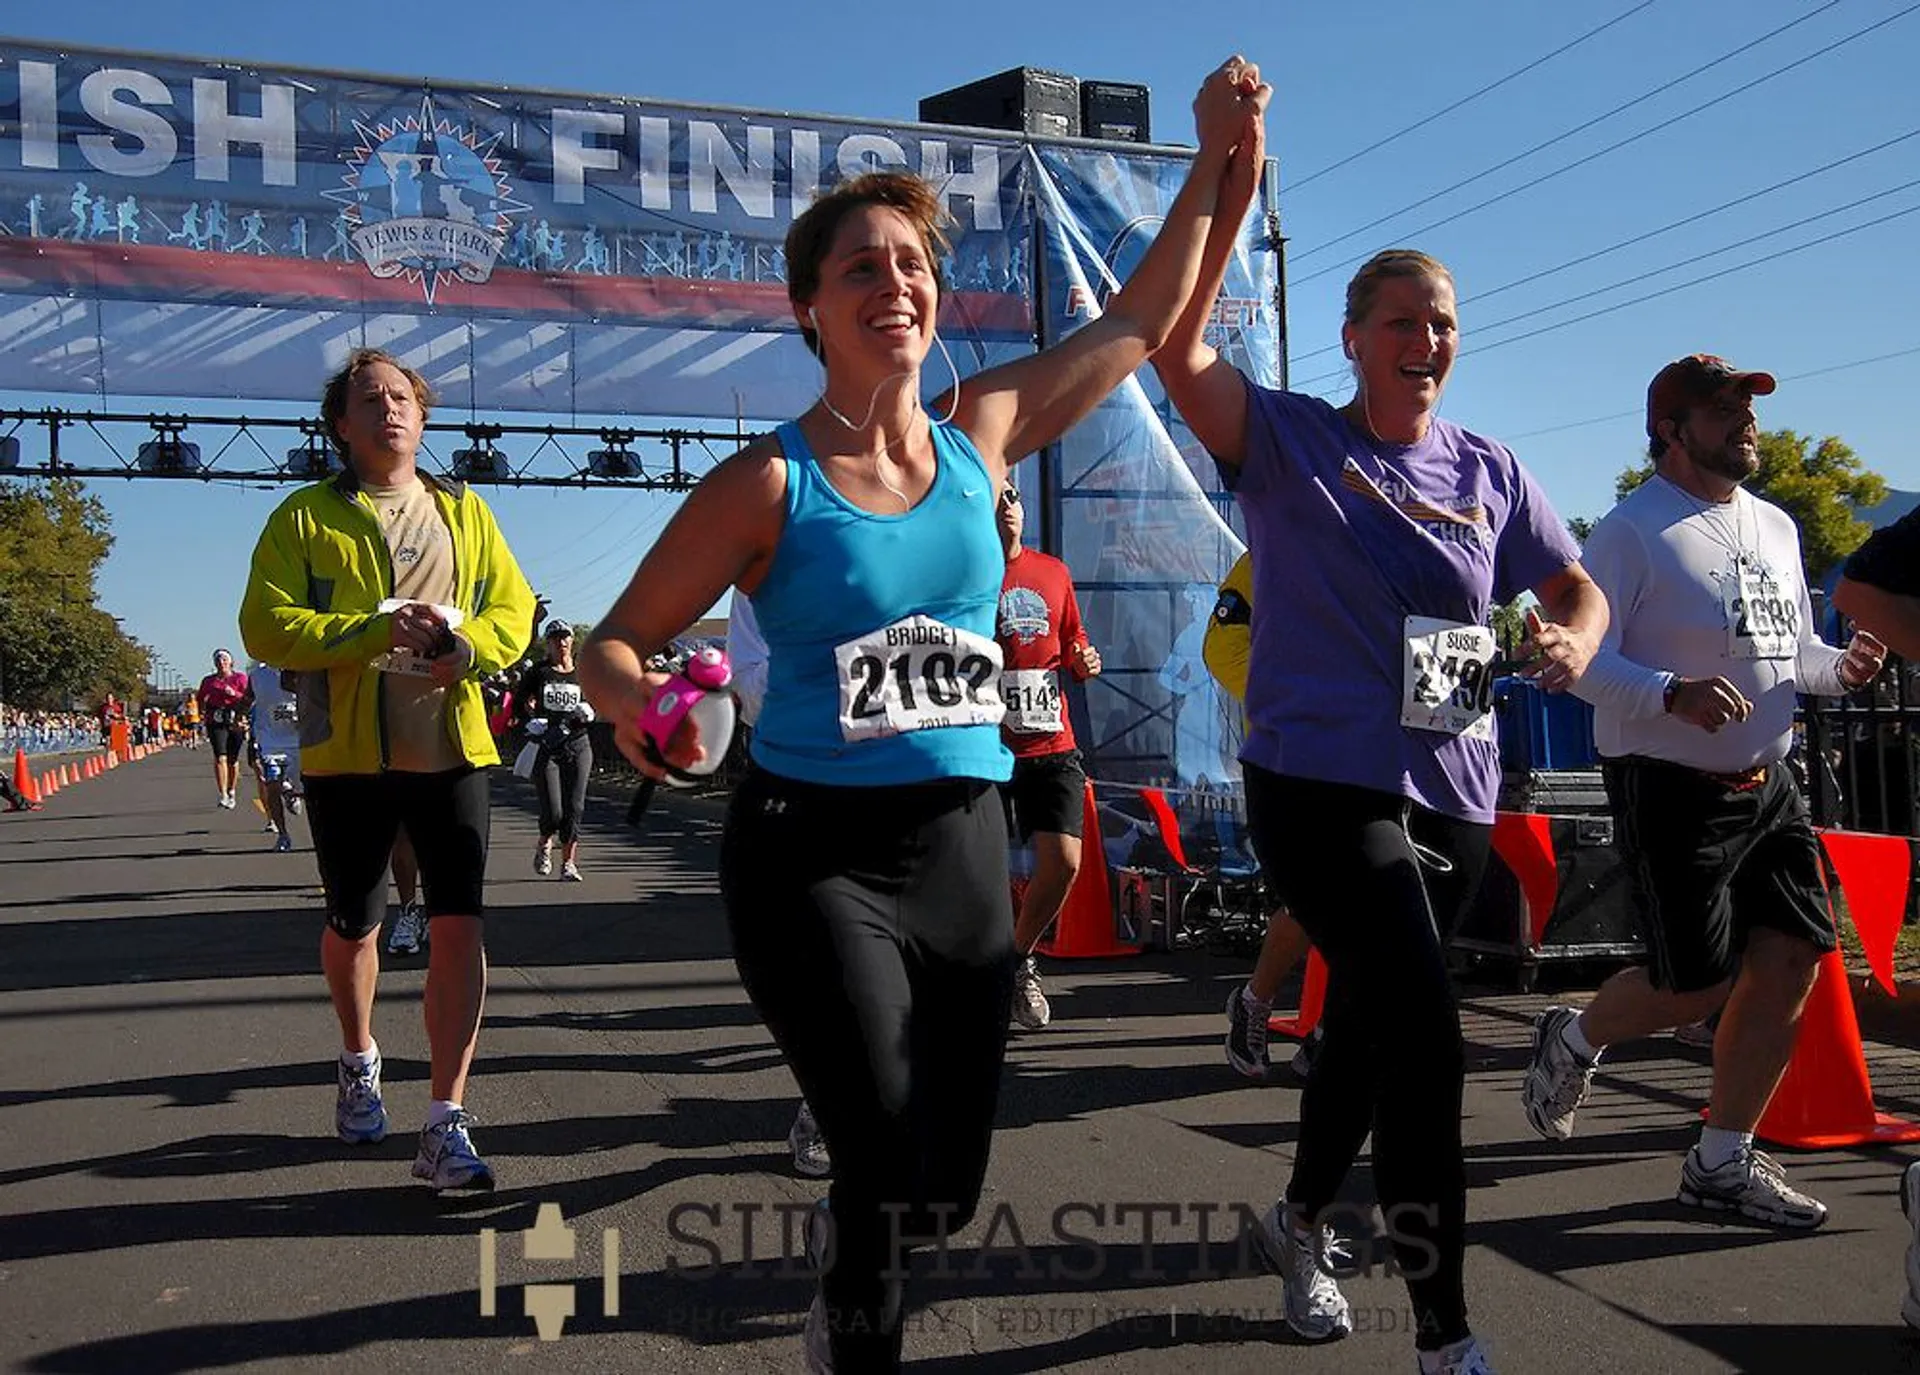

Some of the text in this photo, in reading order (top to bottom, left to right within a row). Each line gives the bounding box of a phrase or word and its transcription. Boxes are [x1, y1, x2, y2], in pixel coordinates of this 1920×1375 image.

[19, 60, 298, 187] ISH
[365, 225, 418, 250] LEWIS
[421, 228, 434, 242] &
[438, 228, 491, 257] CLARK
[1446, 631, 1480, 653] SUSIE
[850, 652, 993, 719] 2102
